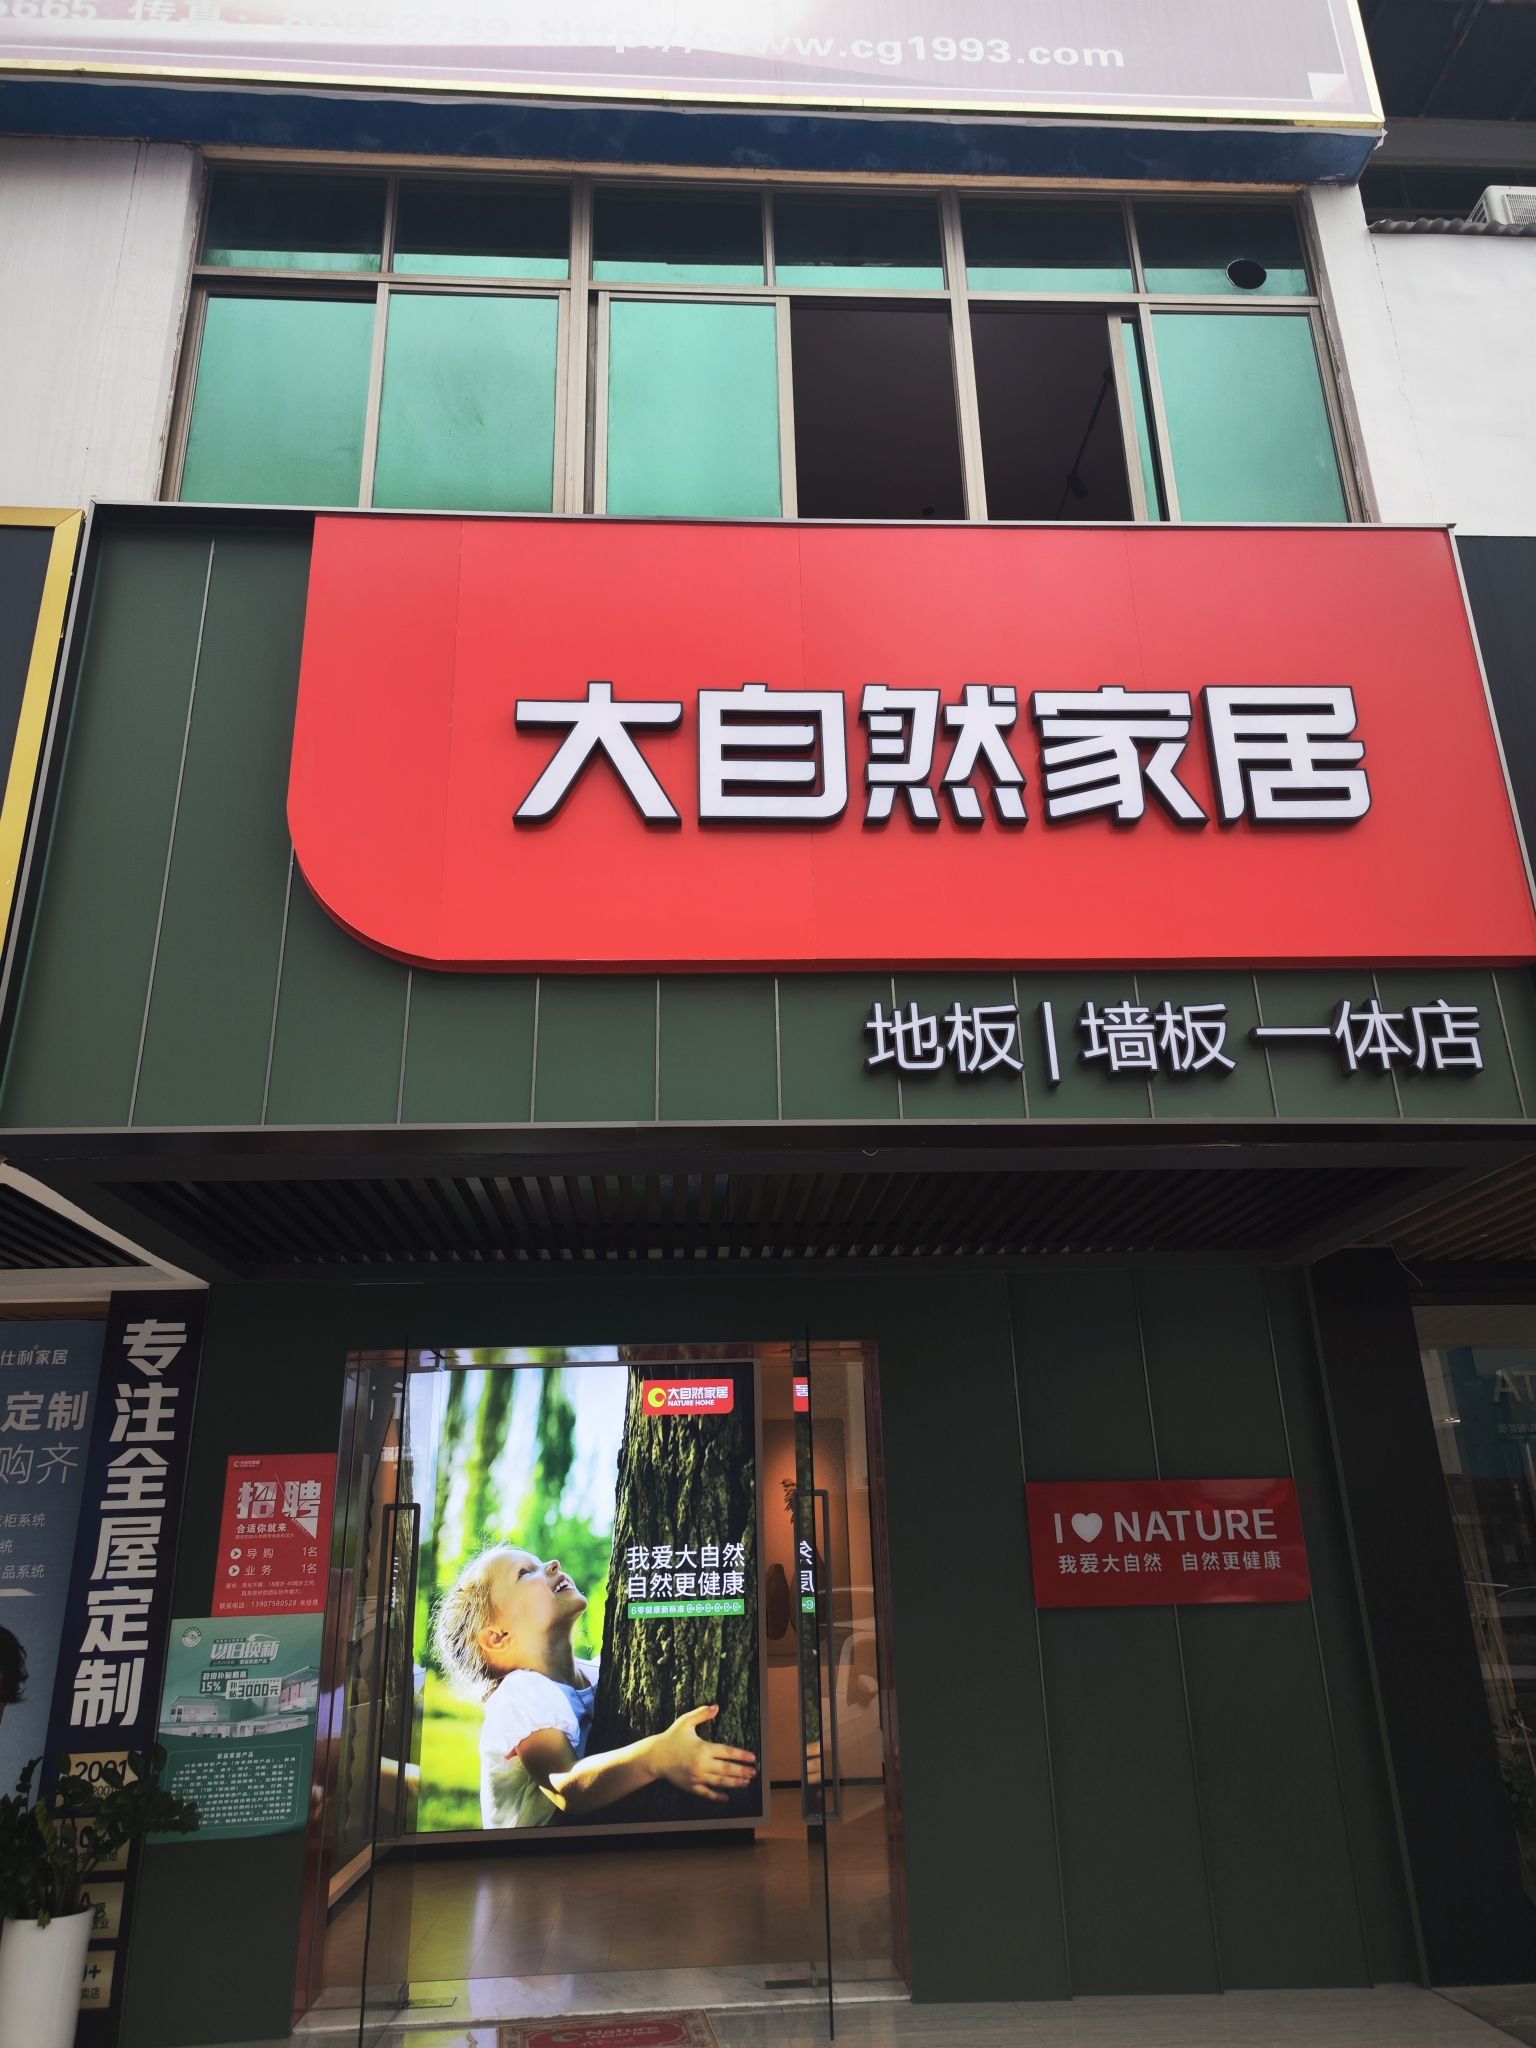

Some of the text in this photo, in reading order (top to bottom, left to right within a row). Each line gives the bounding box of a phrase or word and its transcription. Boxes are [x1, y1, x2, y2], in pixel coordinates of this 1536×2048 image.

[512, 682, 1374, 826] 大自然家居
[667, 1385, 728, 1400] 大自然家居
[0, 1390, 89, 1432] 定制
[236, 1479, 322, 1519] 招聘
[69, 1318, 188, 1728] 专注全屋定制
[236, 1522, 287, 1534] 合适你就来
[1054, 1508, 1278, 1544] I NATURE
[627, 1543, 745, 1570] 我爱大自然
[1059, 1551, 1282, 1574] 我爱大自然 自然更健康
[0, 1565, 45, 1580] 品系统
[627, 1570, 745, 1598] 自然更健康
[201, 1681, 222, 1692] 15%
[238, 1683, 279, 1698] 3000元
